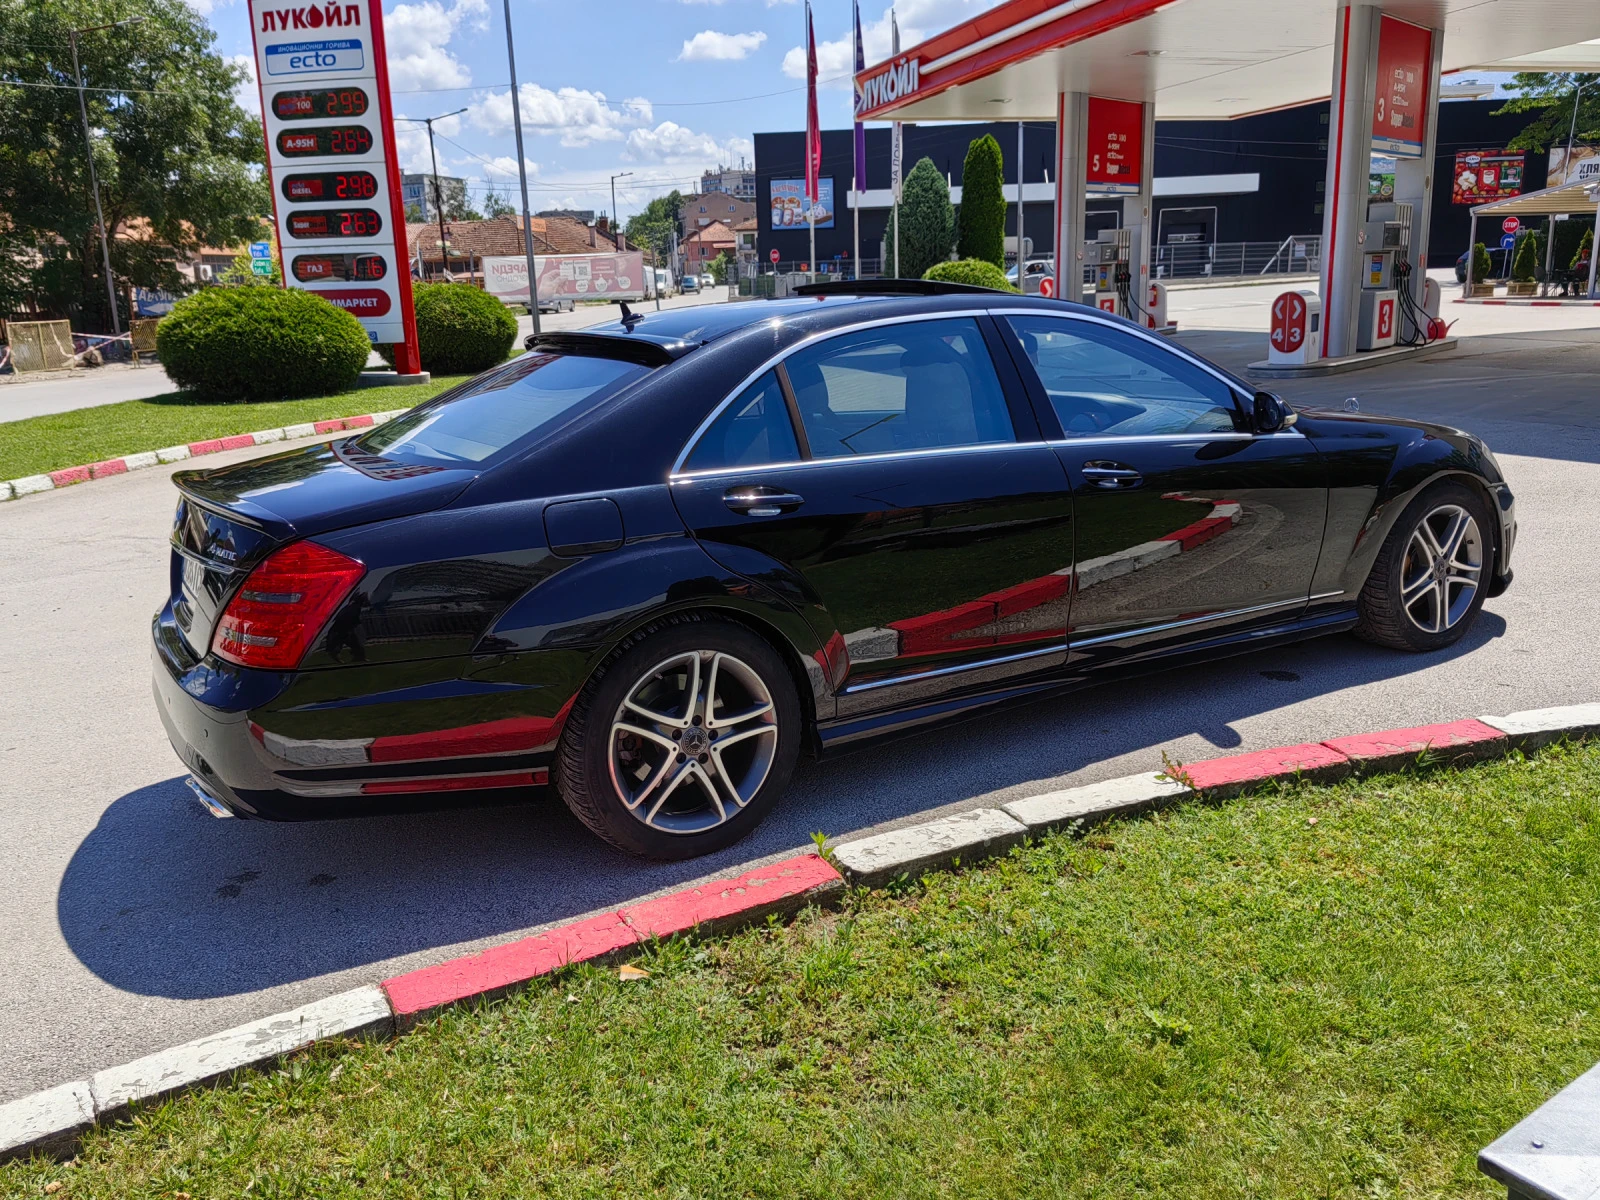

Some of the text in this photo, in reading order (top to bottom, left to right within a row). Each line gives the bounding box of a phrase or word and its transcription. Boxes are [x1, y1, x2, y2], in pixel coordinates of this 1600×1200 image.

[261, 1, 361, 33] ЛУКОЙЛ
[277, 41, 351, 53] ИНОВАЦИОННИ ГОРИВА
[289, 51, 337, 69] ecto
[862, 57, 919, 112] ЛУКОЙЛ
[296, 100, 311, 110] 100
[1377, 98, 1385, 122] 3
[286, 138, 315, 148] A-95H
[1092, 154, 1100, 172] 5
[1504, 221, 1518, 229] STOP
[307, 264, 323, 273] ГАЗ
[1381, 304, 1390, 333] 3
[1271, 327, 1301, 342] 4 3
